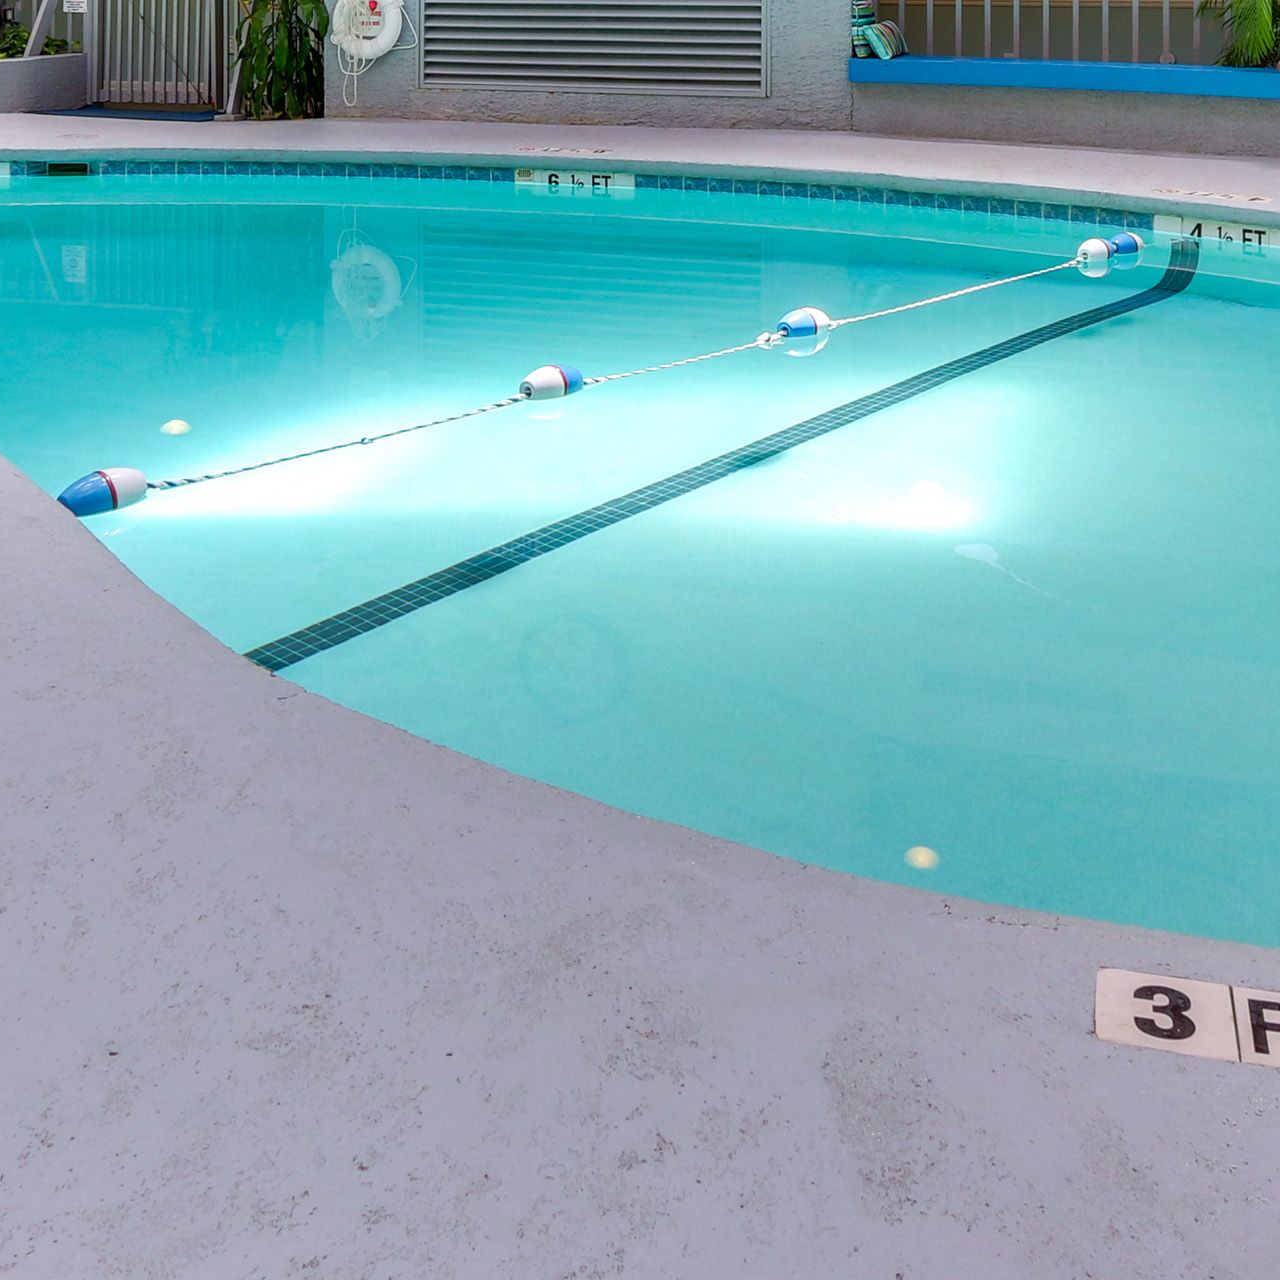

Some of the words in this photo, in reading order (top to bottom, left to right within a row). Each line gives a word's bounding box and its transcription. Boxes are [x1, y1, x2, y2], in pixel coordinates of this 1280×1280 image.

[591, 175, 611, 188] FT
[1242, 228, 1266, 246] FT
[1132, 985, 1196, 1040] 3
